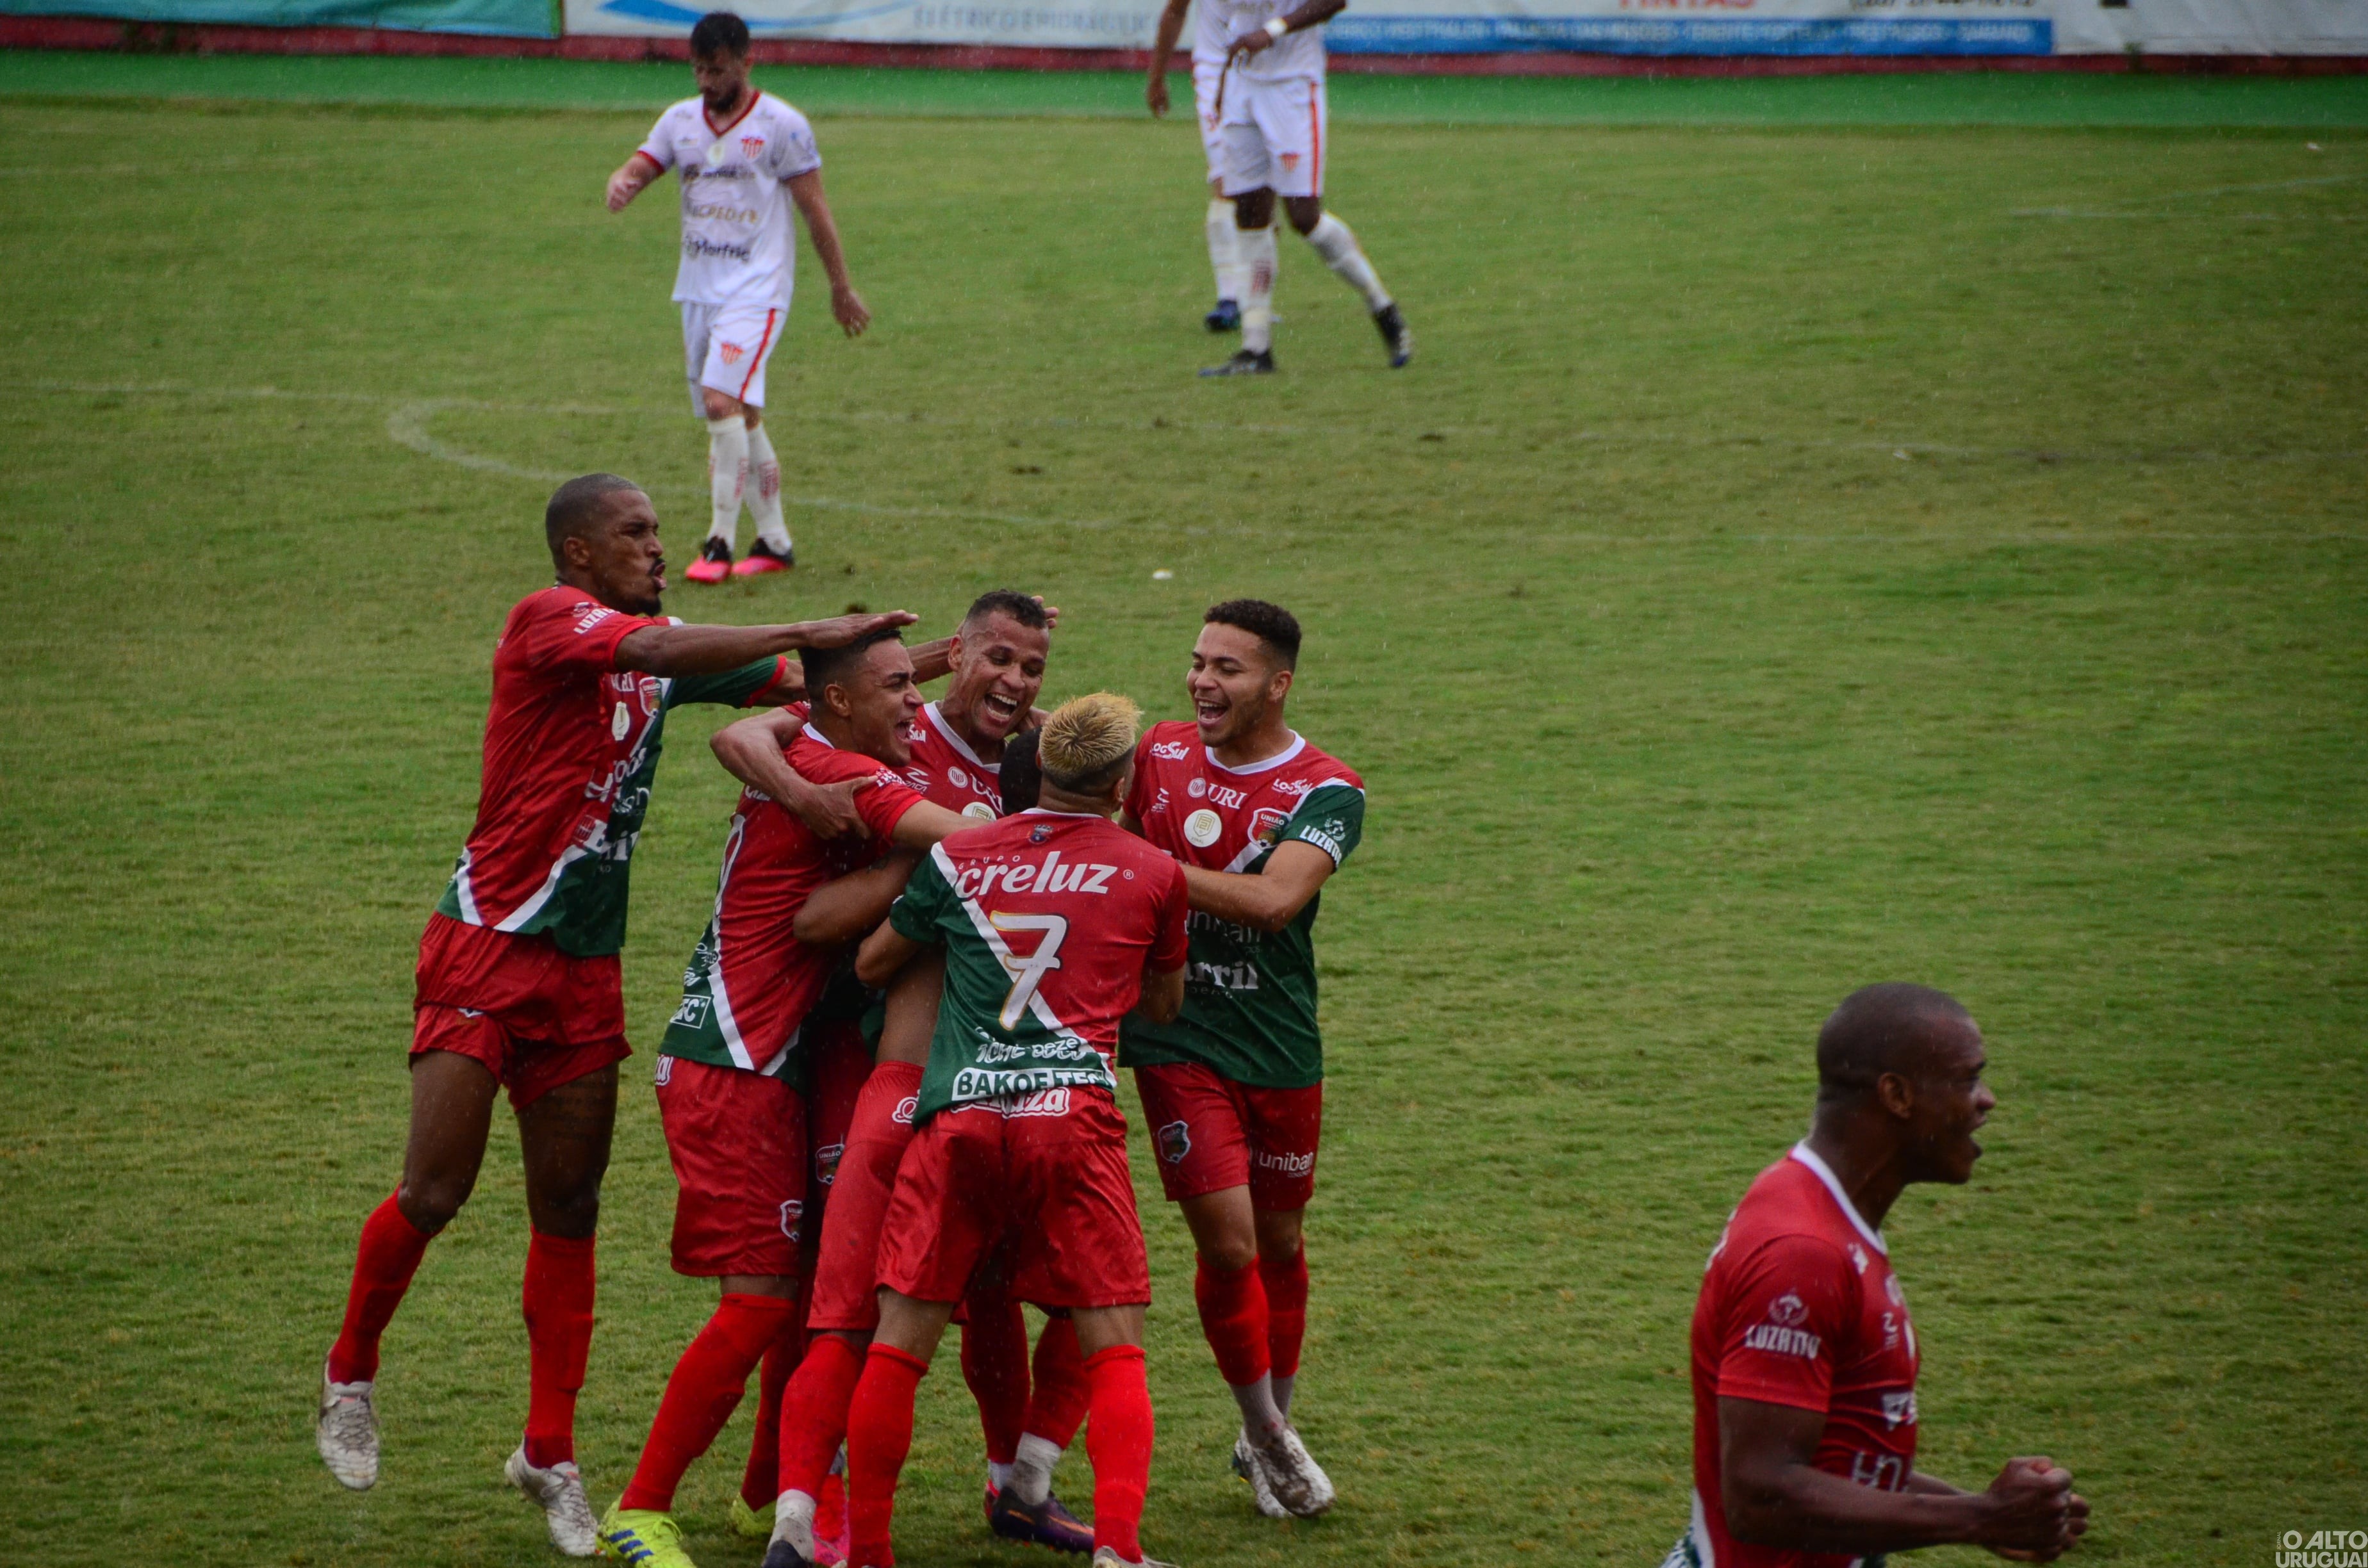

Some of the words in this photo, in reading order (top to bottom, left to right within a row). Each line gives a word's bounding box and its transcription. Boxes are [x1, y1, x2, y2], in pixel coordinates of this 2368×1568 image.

[1208, 783, 1247, 809] URI
[955, 851, 1118, 899] creluz
[958, 854, 1021, 870] GRUPO
[987, 910, 1070, 1031] 7
[957, 1072, 1049, 1097] BAKOF
